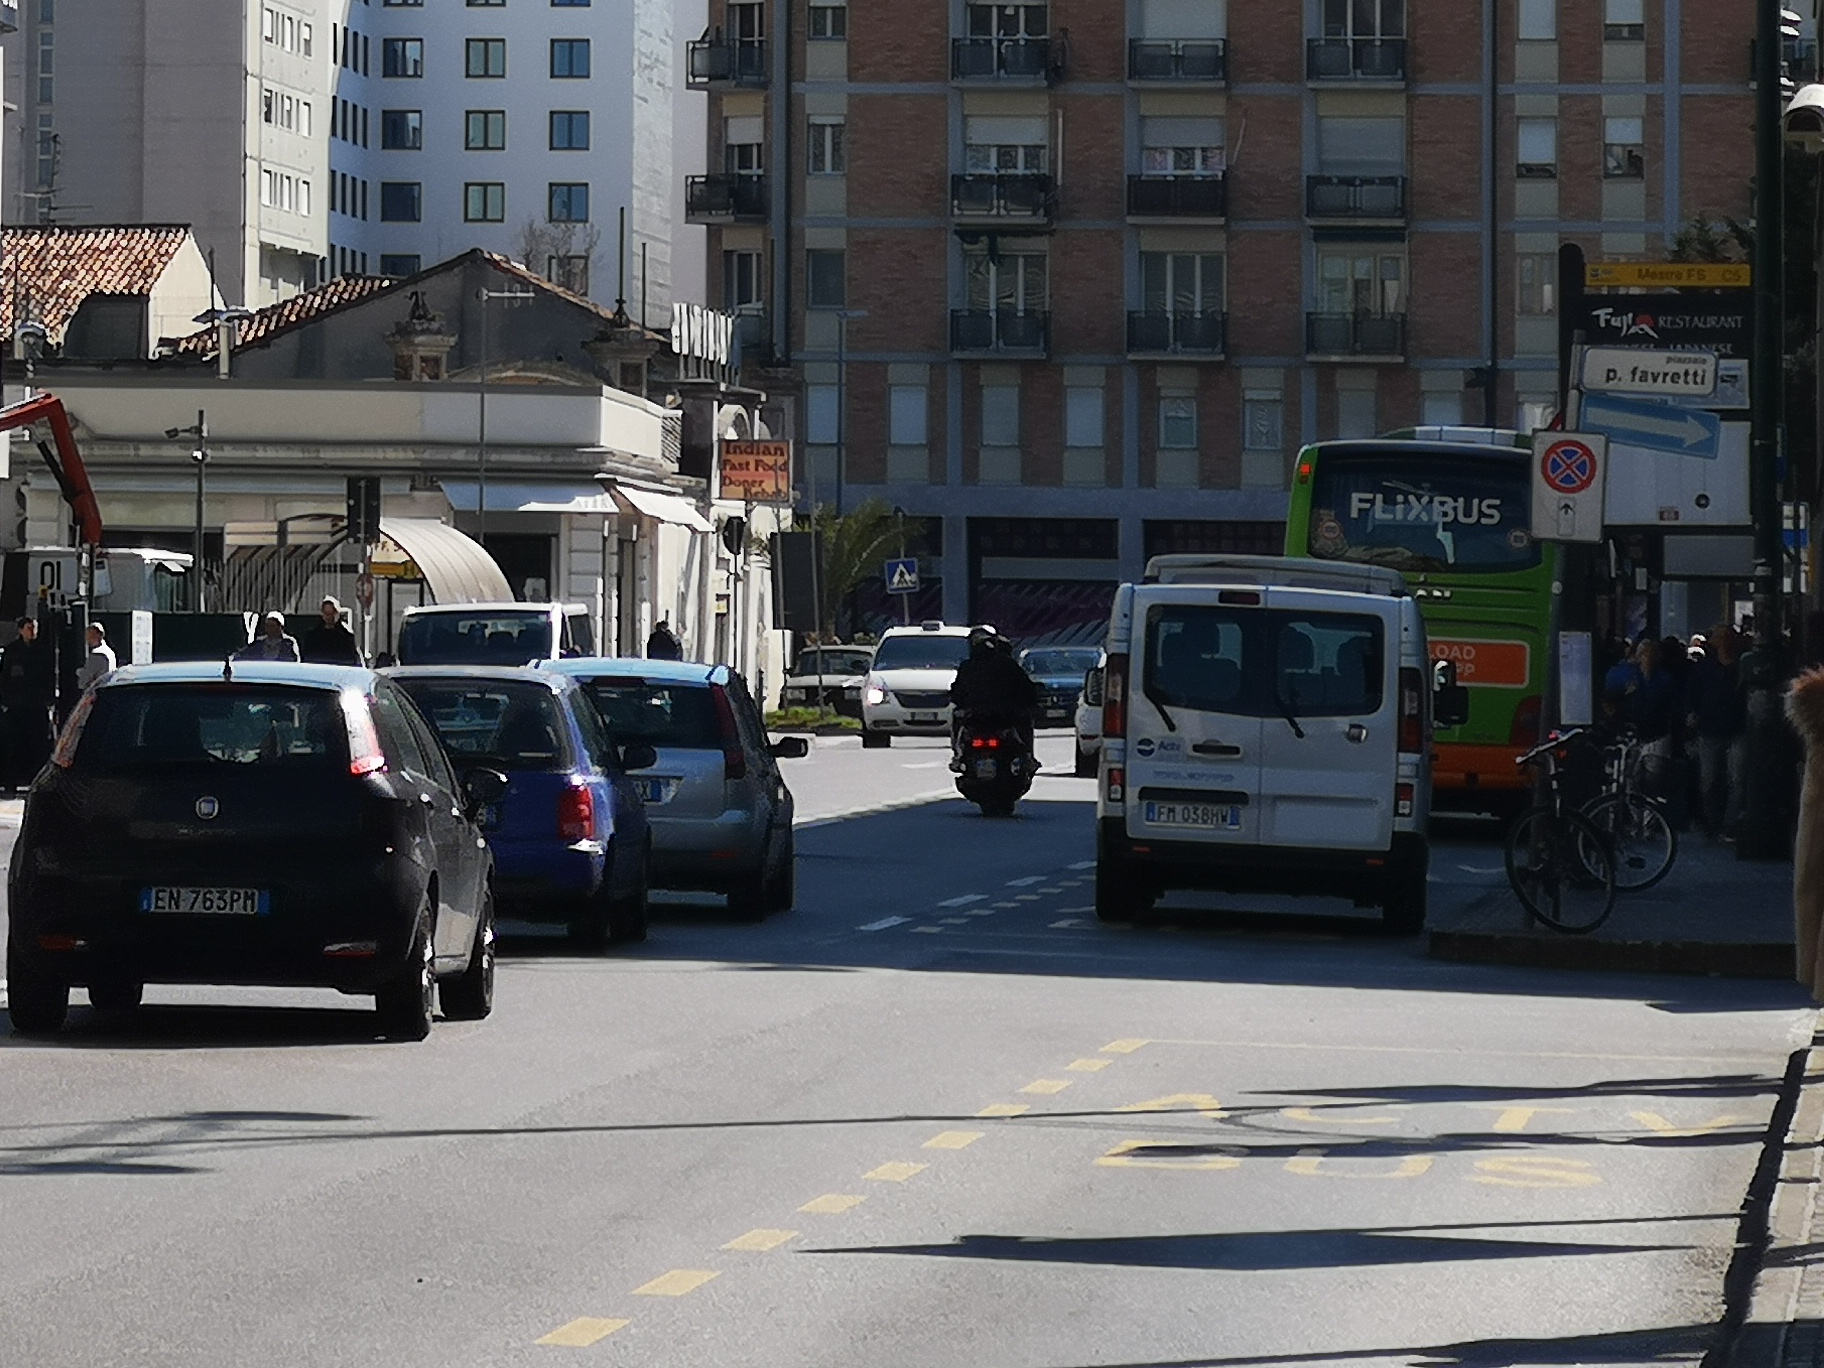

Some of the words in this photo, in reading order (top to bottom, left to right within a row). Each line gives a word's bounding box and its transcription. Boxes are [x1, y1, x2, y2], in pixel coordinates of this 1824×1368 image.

[1591, 307, 1634, 337] Fuji
[1658, 315, 1745, 329] RESTAURANT
[1605, 367, 1622, 383] p.
[1630, 366, 1707, 386] favretti
[725, 442, 785, 457] Indian
[723, 459, 751, 472] Fast
[154, 888, 179, 911] EN
[188, 888, 257, 913] 763PM
